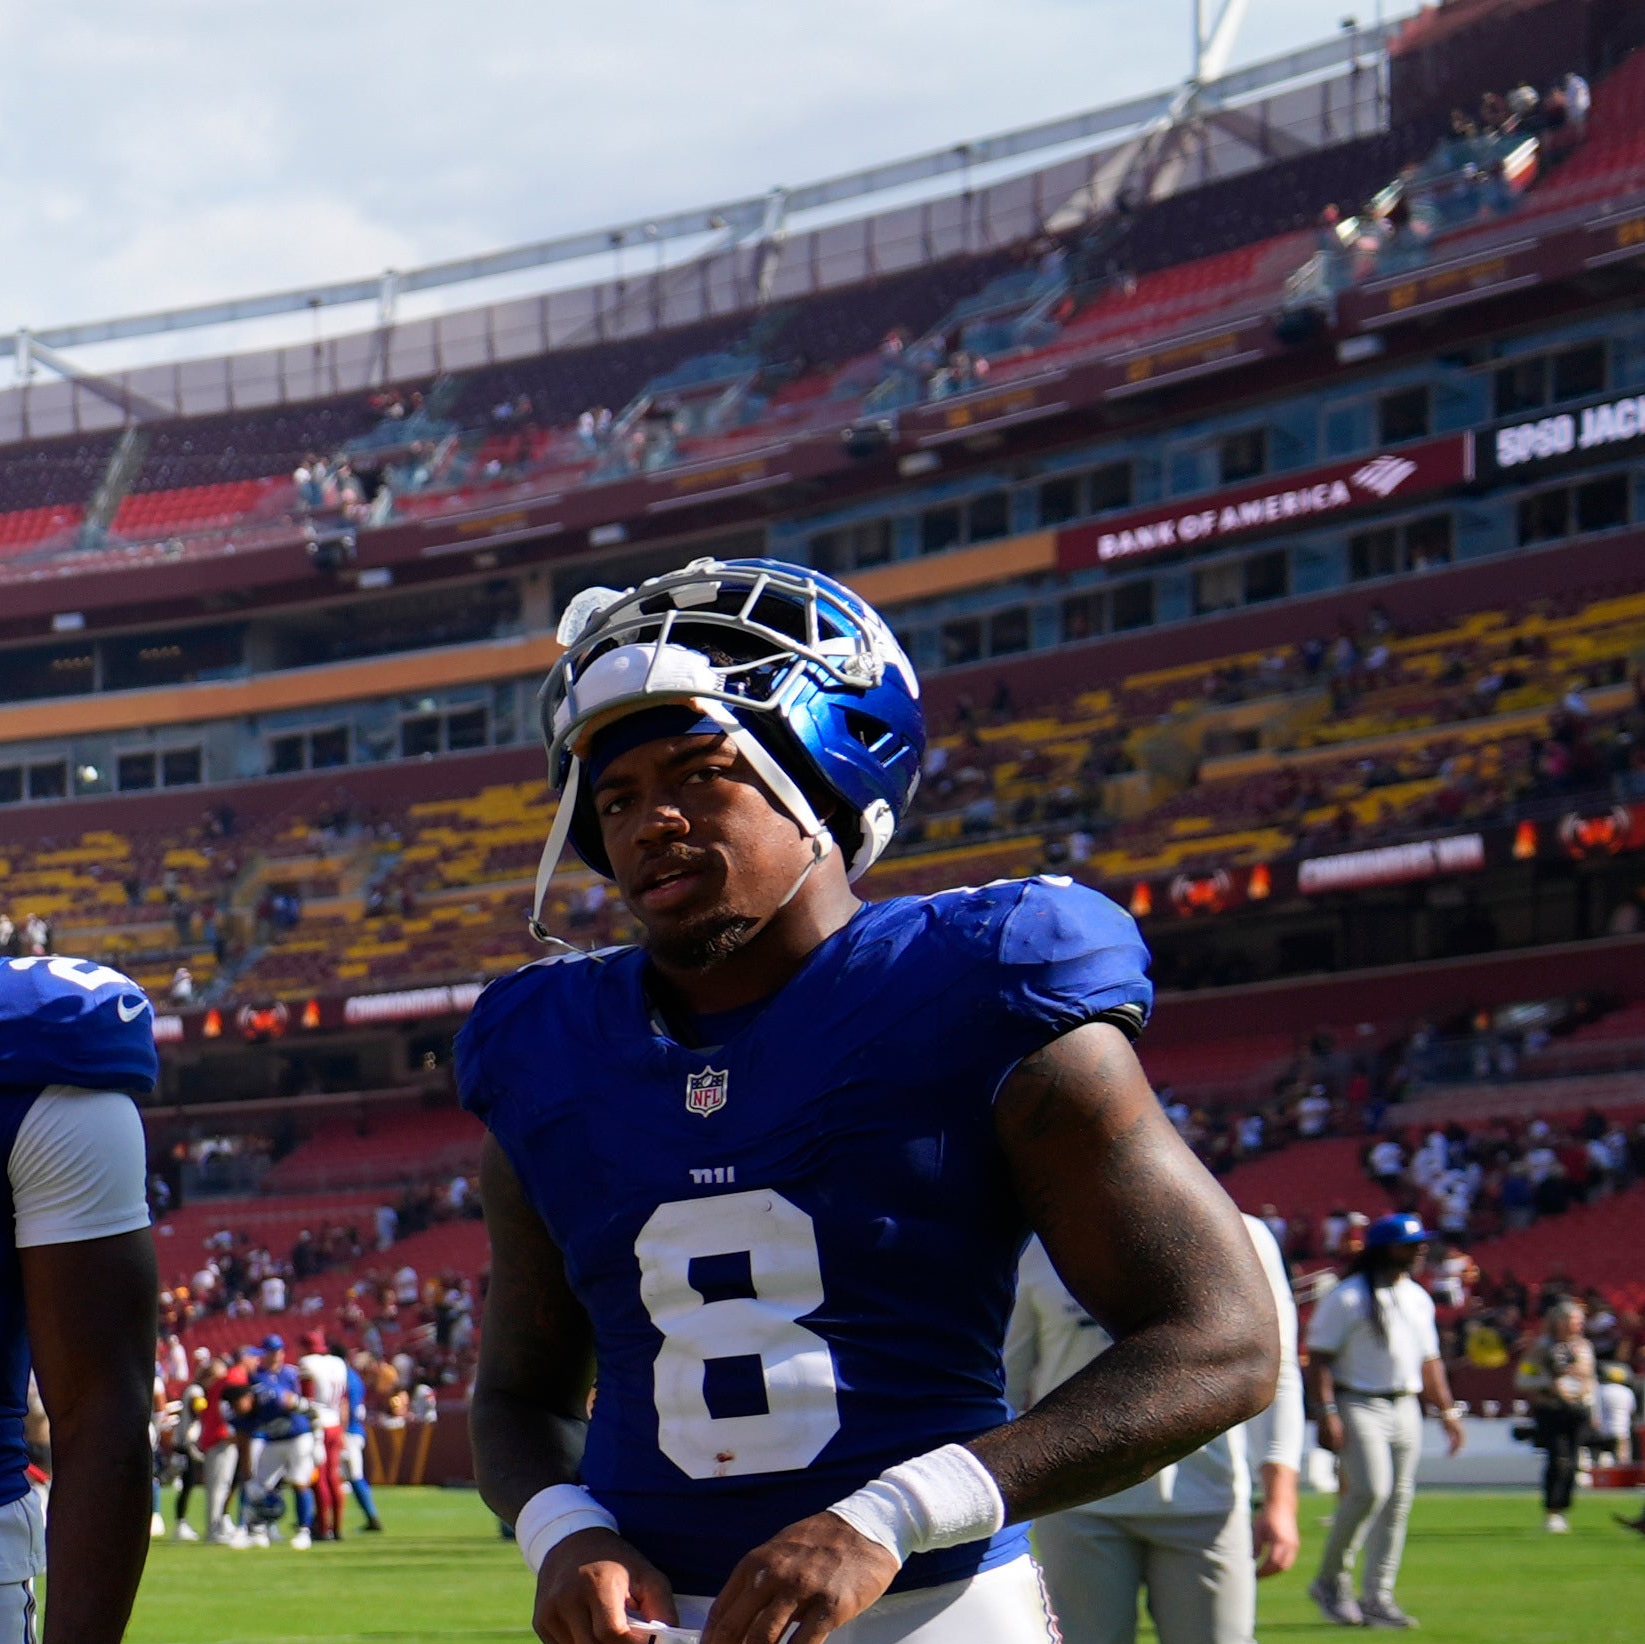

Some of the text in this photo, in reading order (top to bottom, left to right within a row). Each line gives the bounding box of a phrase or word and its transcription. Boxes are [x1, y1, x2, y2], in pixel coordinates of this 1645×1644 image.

[1097, 480, 1352, 560] BANK OF AMERICA
[692, 1088, 721, 1108] NFL
[634, 1188, 841, 1479] 8
